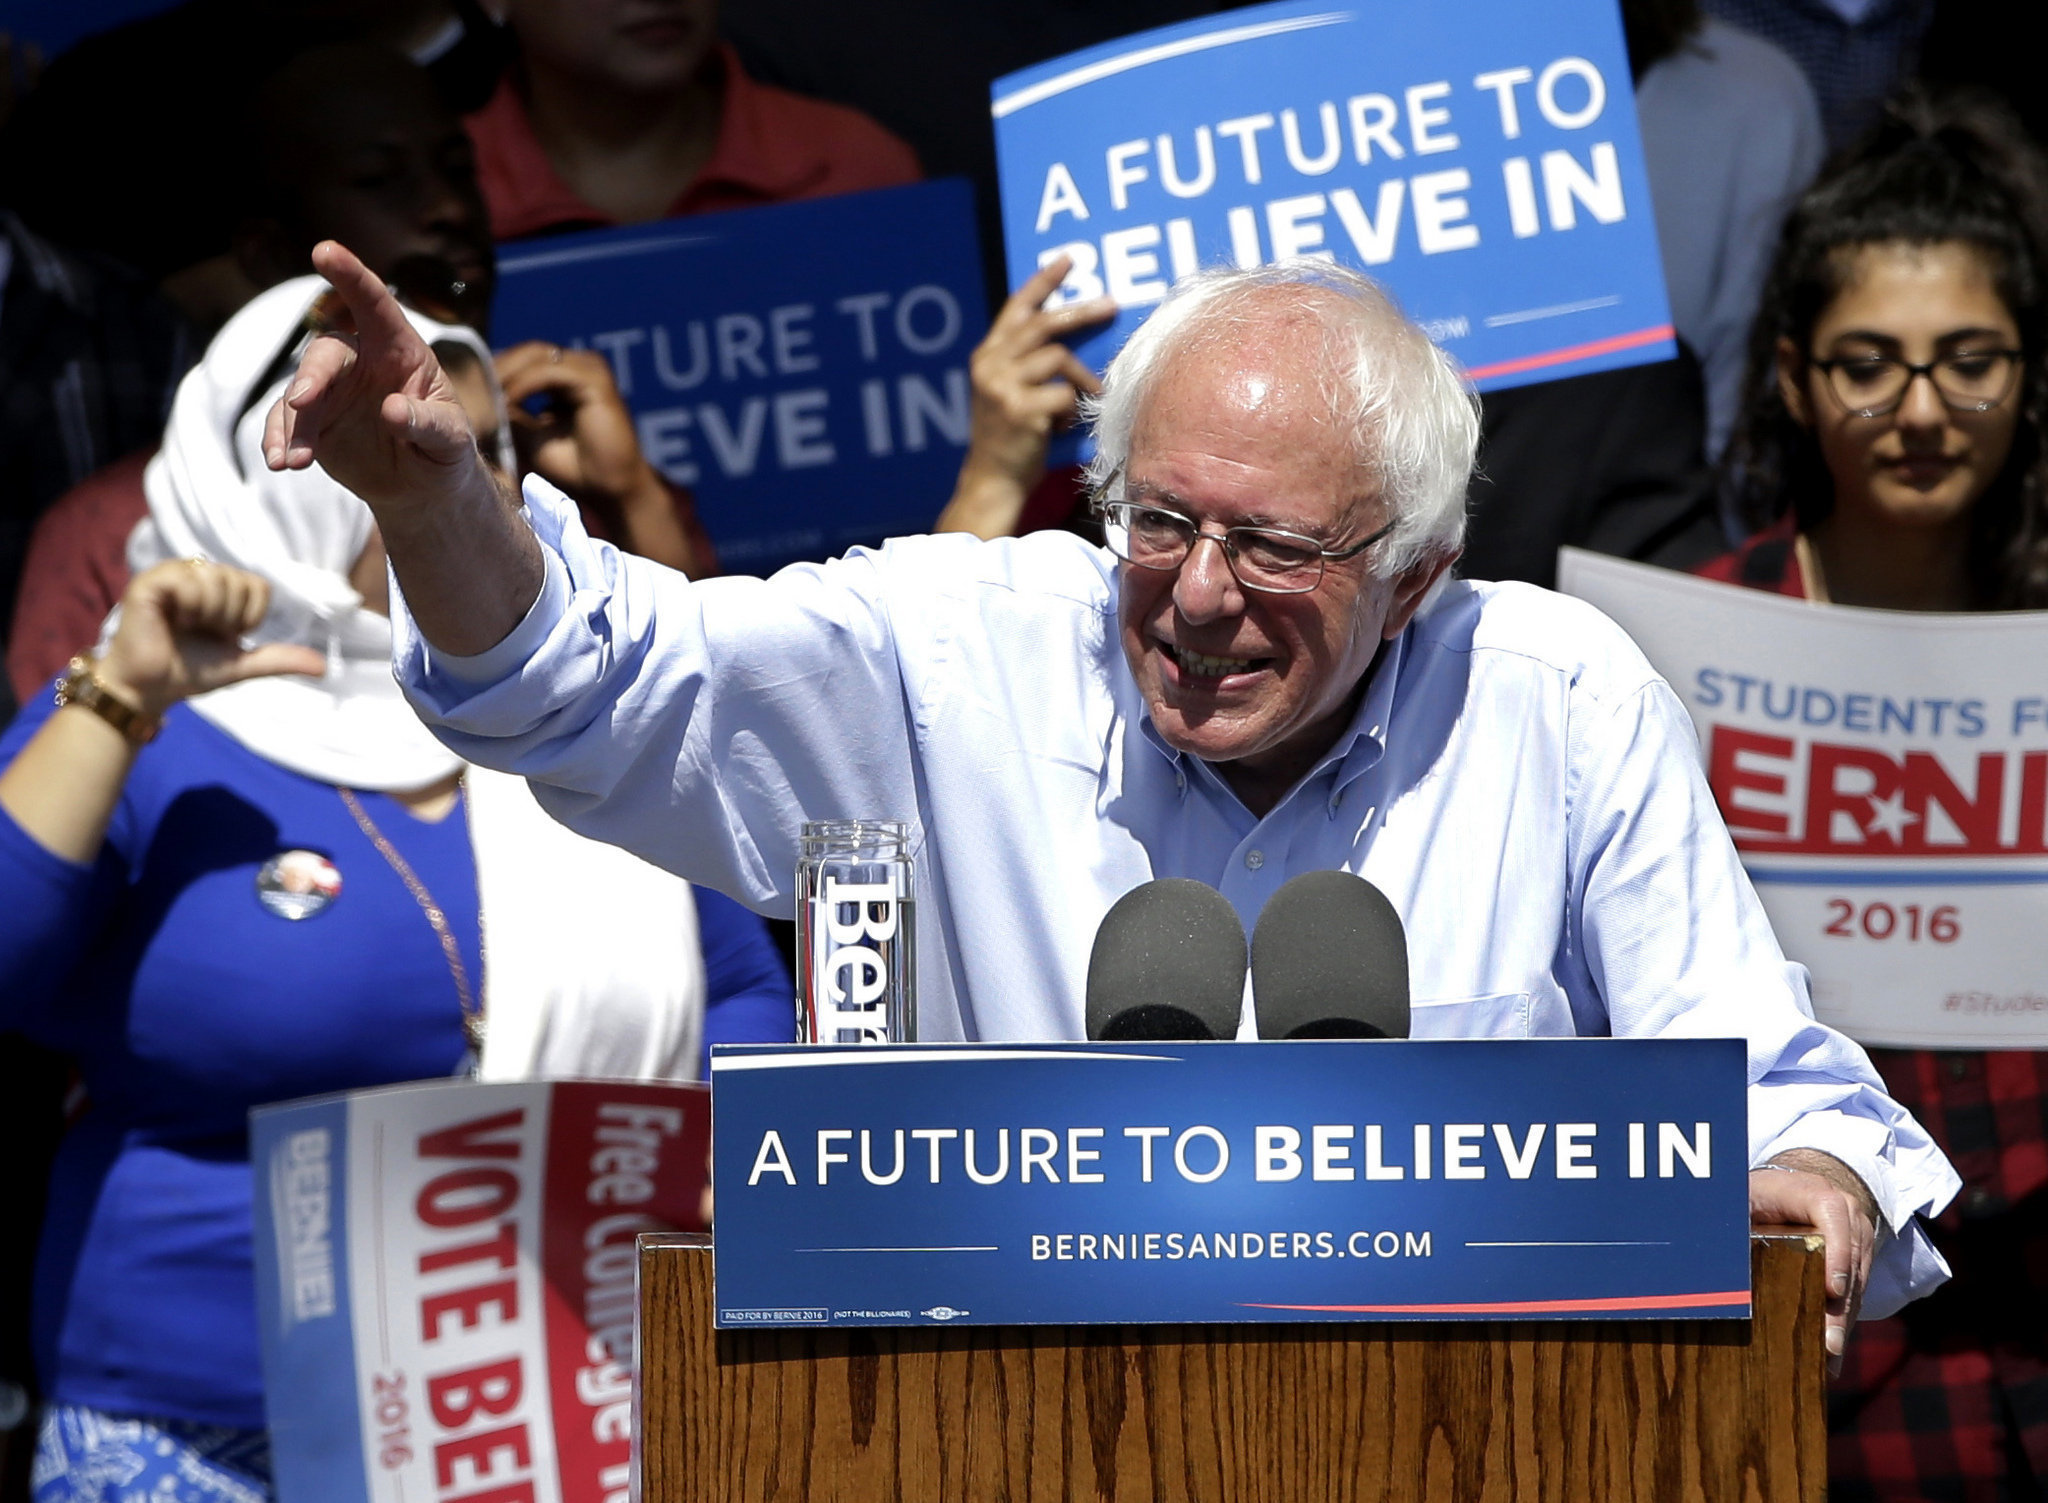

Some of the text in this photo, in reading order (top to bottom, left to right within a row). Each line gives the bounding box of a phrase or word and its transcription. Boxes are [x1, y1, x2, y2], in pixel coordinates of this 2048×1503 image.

[1036, 57, 1605, 233] A FUTURE TO
[1503, 142, 1626, 238] IN
[573, 284, 963, 396] TURE TO
[861, 368, 971, 457] IN
[1695, 668, 2048, 739] STUDENTS F
[1709, 724, 2048, 856] ERNI
[1823, 899, 1961, 944] 2016
[587, 1104, 684, 1205] Free
[748, 1121, 1712, 1185] A FUTURE TO BELIEVE IN
[1031, 1231, 1432, 1261] BERNIESANDERS.COM
[416, 1107, 537, 1503] VOTE BE
[725, 1311, 823, 1320] PAID FOR BY BERNIE 2016
[371, 1369, 414, 1470] 2016
